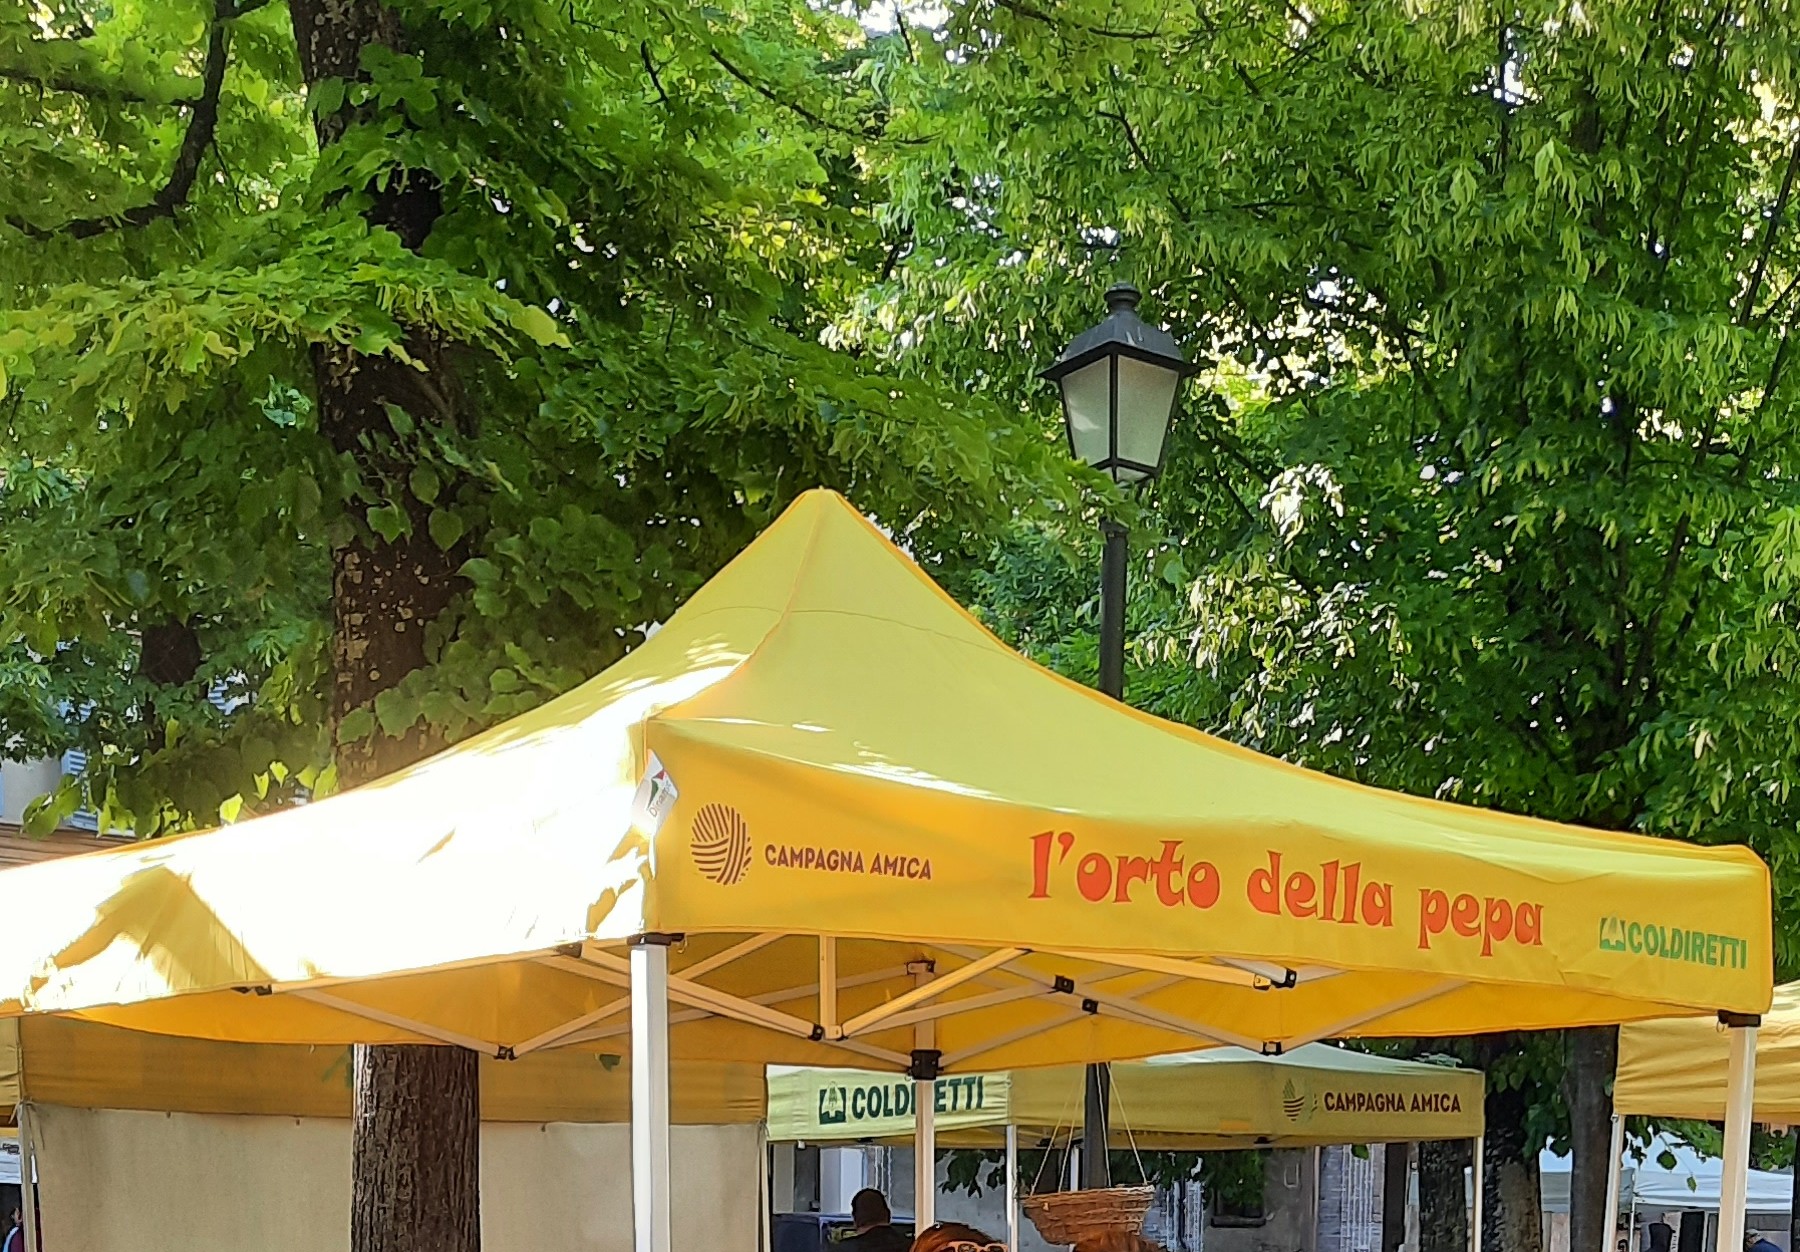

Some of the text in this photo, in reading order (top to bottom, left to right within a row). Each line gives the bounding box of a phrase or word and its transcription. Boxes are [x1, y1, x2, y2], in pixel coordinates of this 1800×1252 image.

[764, 843, 932, 880] CAMPAGNA AMICA
[1028, 831, 1544, 957] l'orto della pepa
[1627, 921, 1747, 970] COLDIRETTI
[852, 1075, 985, 1120] COLDIETTI
[1324, 1092, 1462, 1113] CAMPAGNA AMICA
